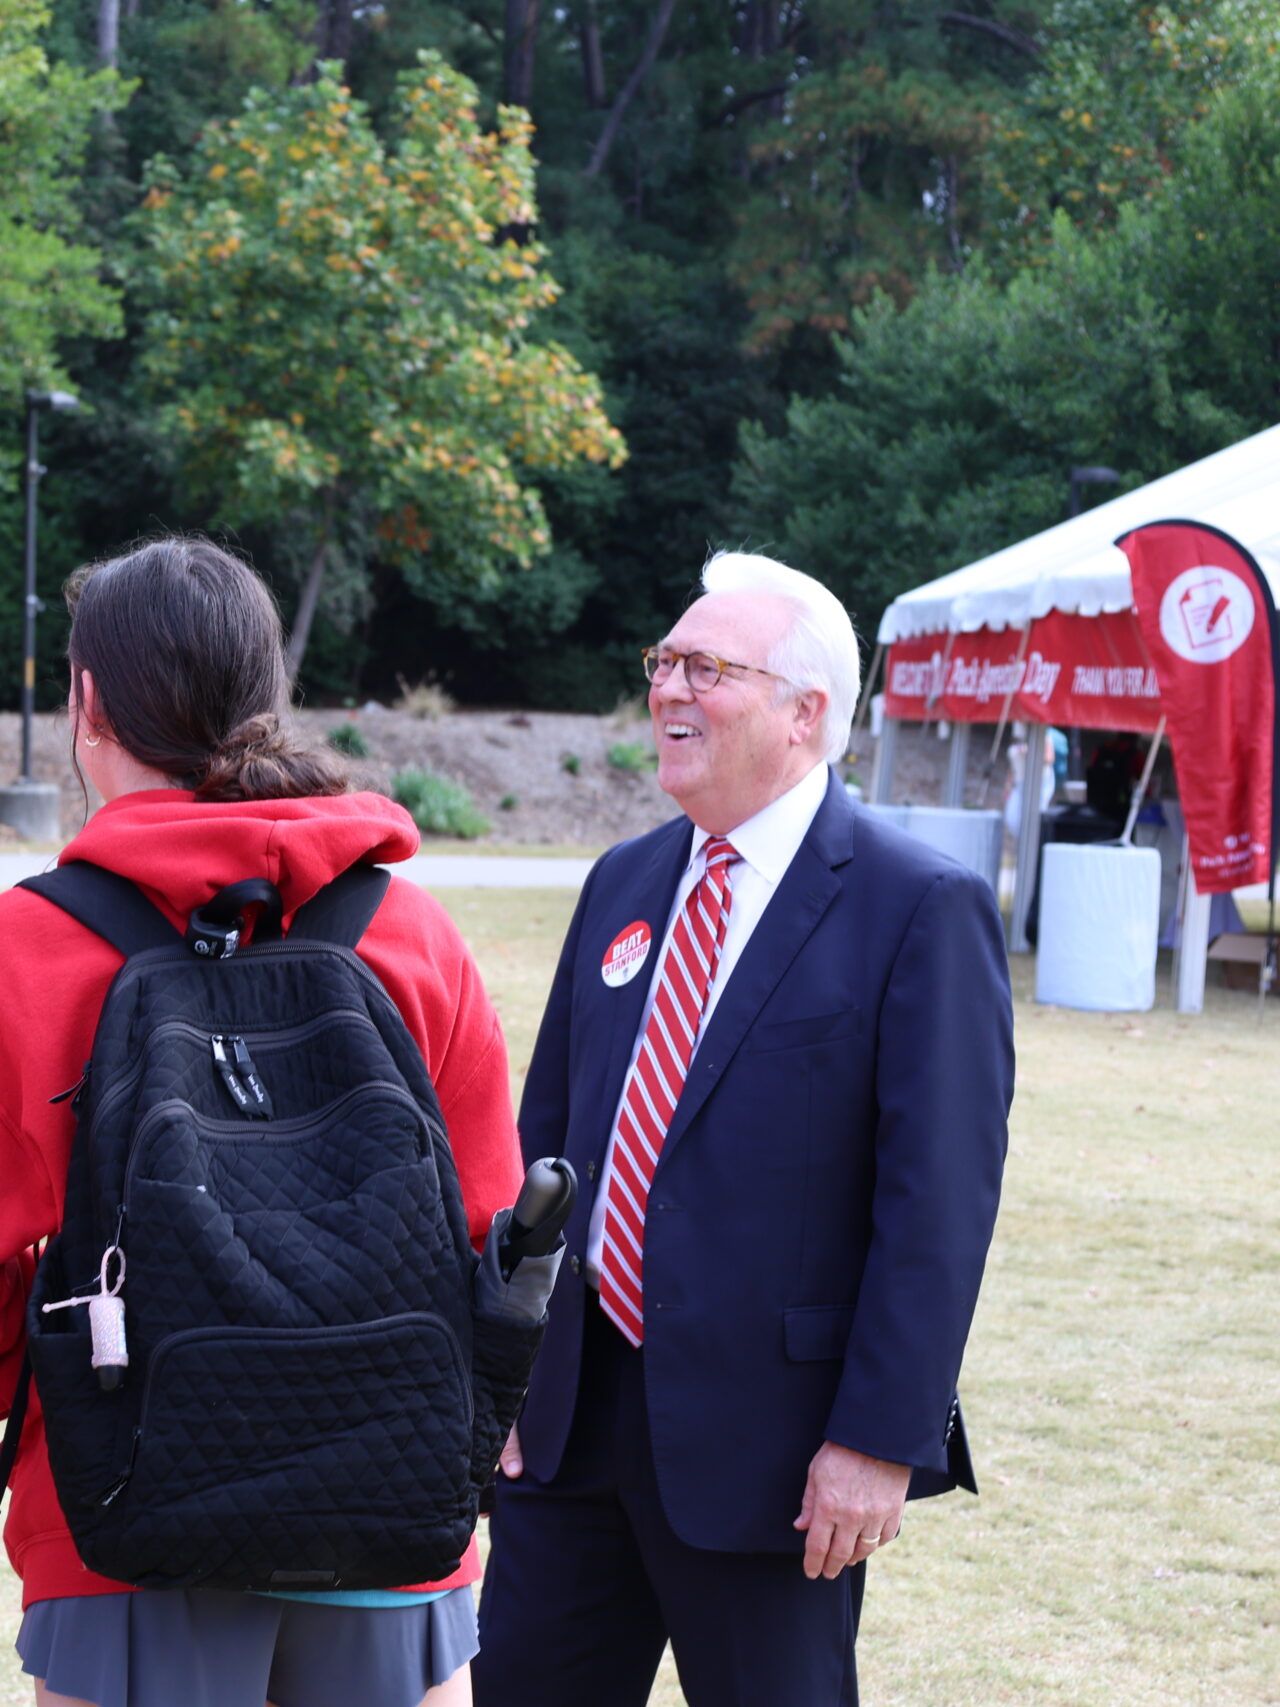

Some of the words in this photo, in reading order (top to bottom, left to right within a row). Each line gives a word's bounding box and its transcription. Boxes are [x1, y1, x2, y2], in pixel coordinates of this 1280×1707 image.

[1022, 651, 1061, 703] Day
[1072, 665, 1104, 695] THANK
[605, 944, 647, 976] STANFORD
[613, 929, 644, 960] BEAT
